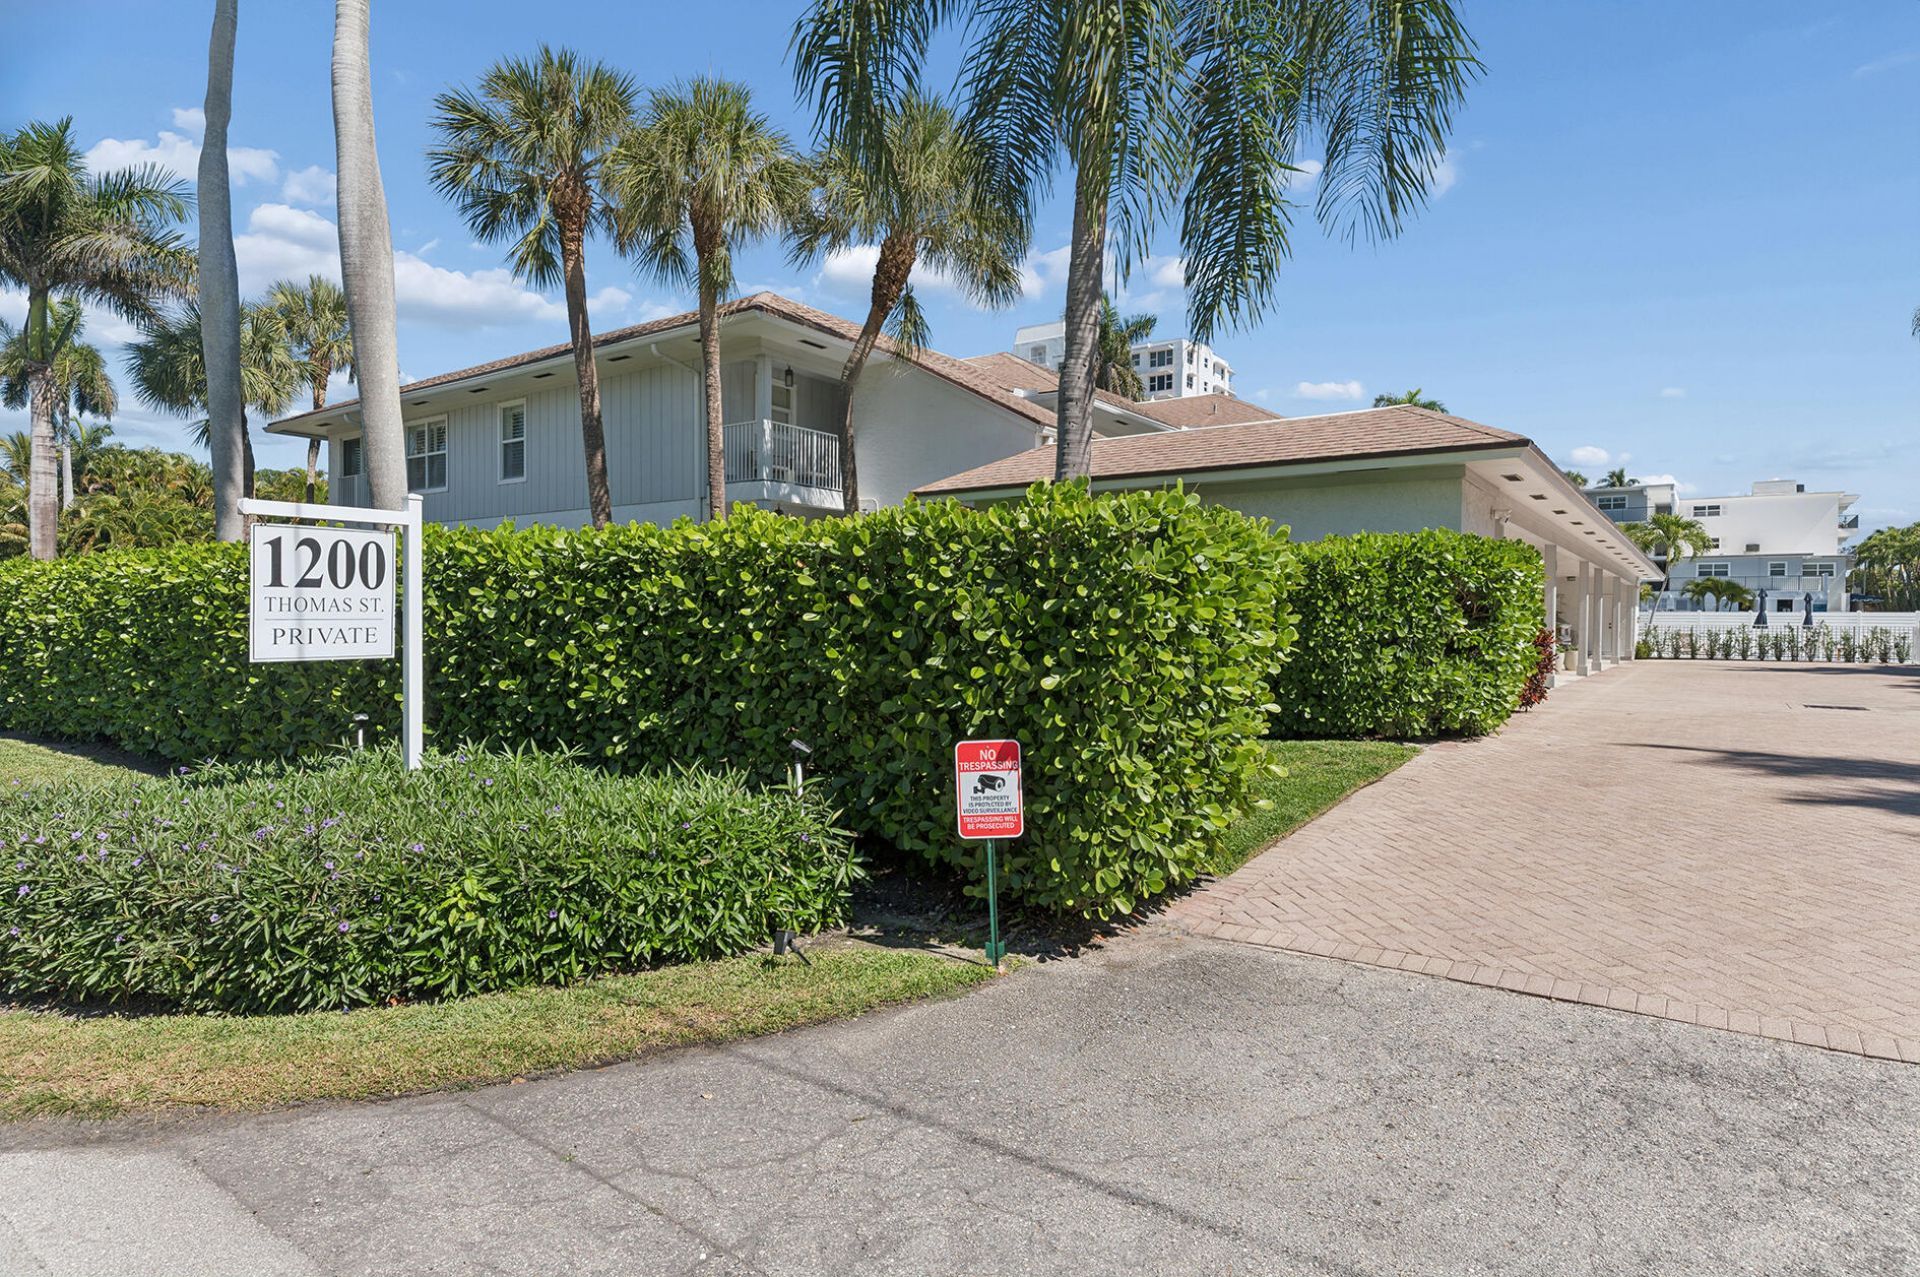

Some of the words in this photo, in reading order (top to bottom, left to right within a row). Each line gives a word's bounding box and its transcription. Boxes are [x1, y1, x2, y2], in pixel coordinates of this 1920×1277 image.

[263, 535, 386, 590] 1200
[264, 597, 352, 612] THOMAS
[359, 597, 384, 613] ST.
[272, 627, 377, 645] PRIVATE
[979, 749, 996, 760] NO
[959, 761, 1018, 770] TRESPASSING
